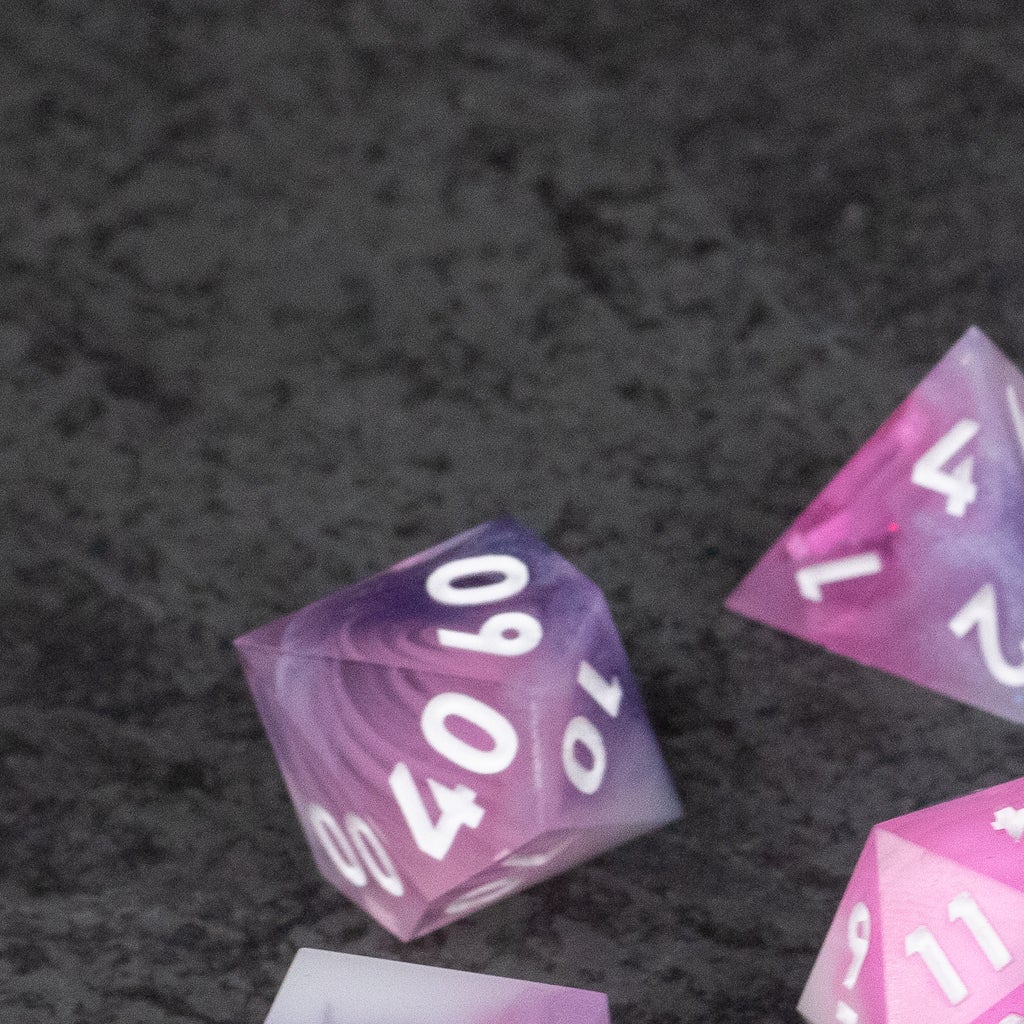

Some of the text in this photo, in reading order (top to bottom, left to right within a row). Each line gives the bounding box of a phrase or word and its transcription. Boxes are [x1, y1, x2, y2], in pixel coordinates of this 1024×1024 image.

[912, 419, 981, 517] 4
[796, 552, 882, 602] 1
[389, 692, 519, 861] 40
[905, 892, 1013, 1006] 11
